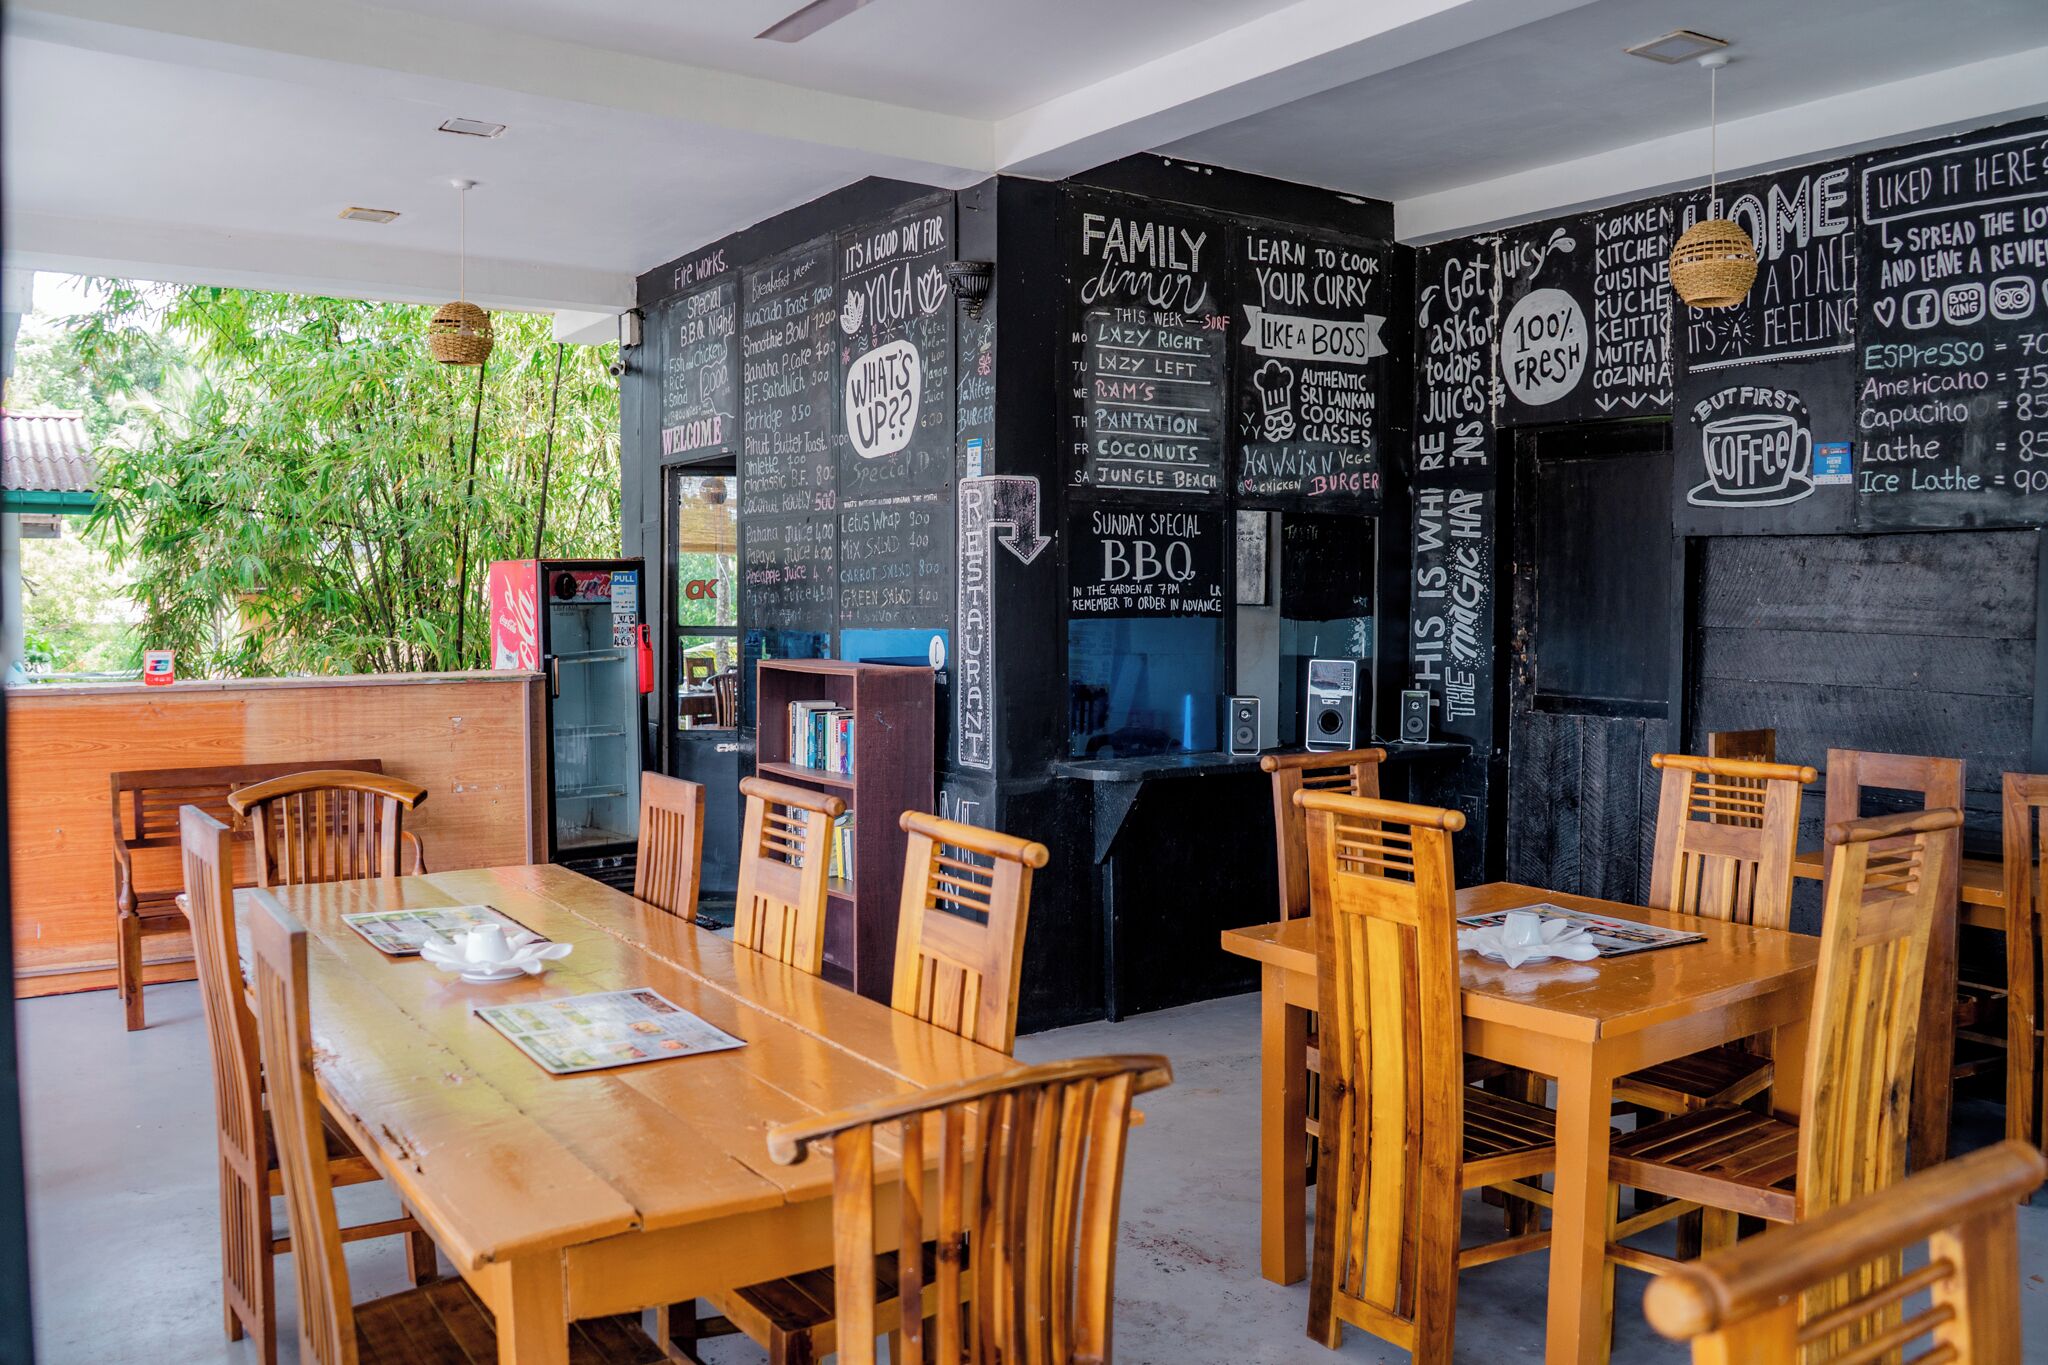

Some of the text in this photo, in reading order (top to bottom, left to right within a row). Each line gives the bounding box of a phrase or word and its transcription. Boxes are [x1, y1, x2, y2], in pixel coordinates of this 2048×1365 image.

[1878, 164, 1962, 209] LIKED IT
[846, 216, 944, 273] IT'S A GOOD DAY FOR
[1083, 213, 1207, 272] FAMILY
[1907, 211, 2014, 251] SPREAD THE
[1247, 235, 1379, 275] LEARN TO COOK
[1595, 234, 1669, 275] KITCHEN
[1763, 265, 1780, 305] A
[1790, 232, 1856, 300] PLACE
[1880, 238, 2048, 290] AND LEAVE A REVIE
[674, 263, 693, 290] Fire
[1081, 252, 1207, 314] dinner
[1256, 267, 1372, 309] YOUR CURRY
[1444, 253, 1490, 312] Get
[1594, 260, 1670, 296] CUISINE
[784, 286, 832, 317] Toast 1000
[865, 262, 913, 326] YOGA
[1594, 282, 1672, 322] KÜCHE
[813, 310, 836, 331] 1200
[1115, 308, 1230, 331] THIS WEEK SURF
[1948, 302, 1979, 317] KING
[1072, 324, 1204, 350] MO LAZY RIGHT
[1261, 317, 1366, 358] LIKE A BOSS
[1430, 306, 1496, 355] ask for
[1513, 307, 1573, 353] 100%
[1688, 320, 1717, 354] IT'S
[1732, 322, 1743, 338] A
[669, 353, 685, 374] Fish
[1072, 353, 1197, 377] TU LAZY LEFT
[1425, 351, 1481, 385] todays
[1593, 361, 1673, 390] COZINHA
[851, 349, 913, 408] WHAT'S
[1301, 367, 1367, 391] AUTHENTIC
[1860, 371, 1989, 401] Americano
[1073, 388, 1089, 399] WE
[1300, 384, 1375, 409] SRI LANKAN
[1693, 386, 1800, 421] BUT FIRST
[745, 404, 811, 432] Porridge 850
[856, 389, 912, 448] UP??
[957, 405, 994, 435] BURGER
[1072, 408, 1197, 434] TH PANTATION
[1301, 404, 1372, 428] COOKING
[662, 416, 721, 456] WELCOME
[773, 432, 802, 455] Butter
[1074, 439, 1199, 461] FR COCONUTS
[1302, 424, 1371, 448] CLASSES
[1862, 434, 1940, 463] Lathe
[1074, 467, 1217, 488] SA JUNGLE BEACH
[1307, 472, 1379, 496] BURGER
[1859, 465, 1981, 492] Ice Lathe
[909, 510, 930, 526] 900
[1093, 510, 1201, 538] SUNDAY SPECIAL
[784, 523, 813, 543] Juice
[815, 522, 834, 544] 400
[783, 543, 811, 565] Juice
[919, 558, 940, 577] 800
[1100, 539, 1196, 583] BBQ
[613, 575, 635, 583] PULL
[784, 565, 807, 582] Juice
[1417, 567, 1448, 597] IS
[841, 588, 878, 608] GREEN
[1072, 596, 1222, 612] REMEMBER TO ORDER IN ADVANCE
[1073, 586, 1082, 598] IN
[1087, 583, 1106, 596] THE
[1109, 584, 1142, 595] GARDEN
[1144, 583, 1153, 595] AT
[963, 488, 985, 757] RESTAURANT
[1445, 667, 1476, 722] THE
